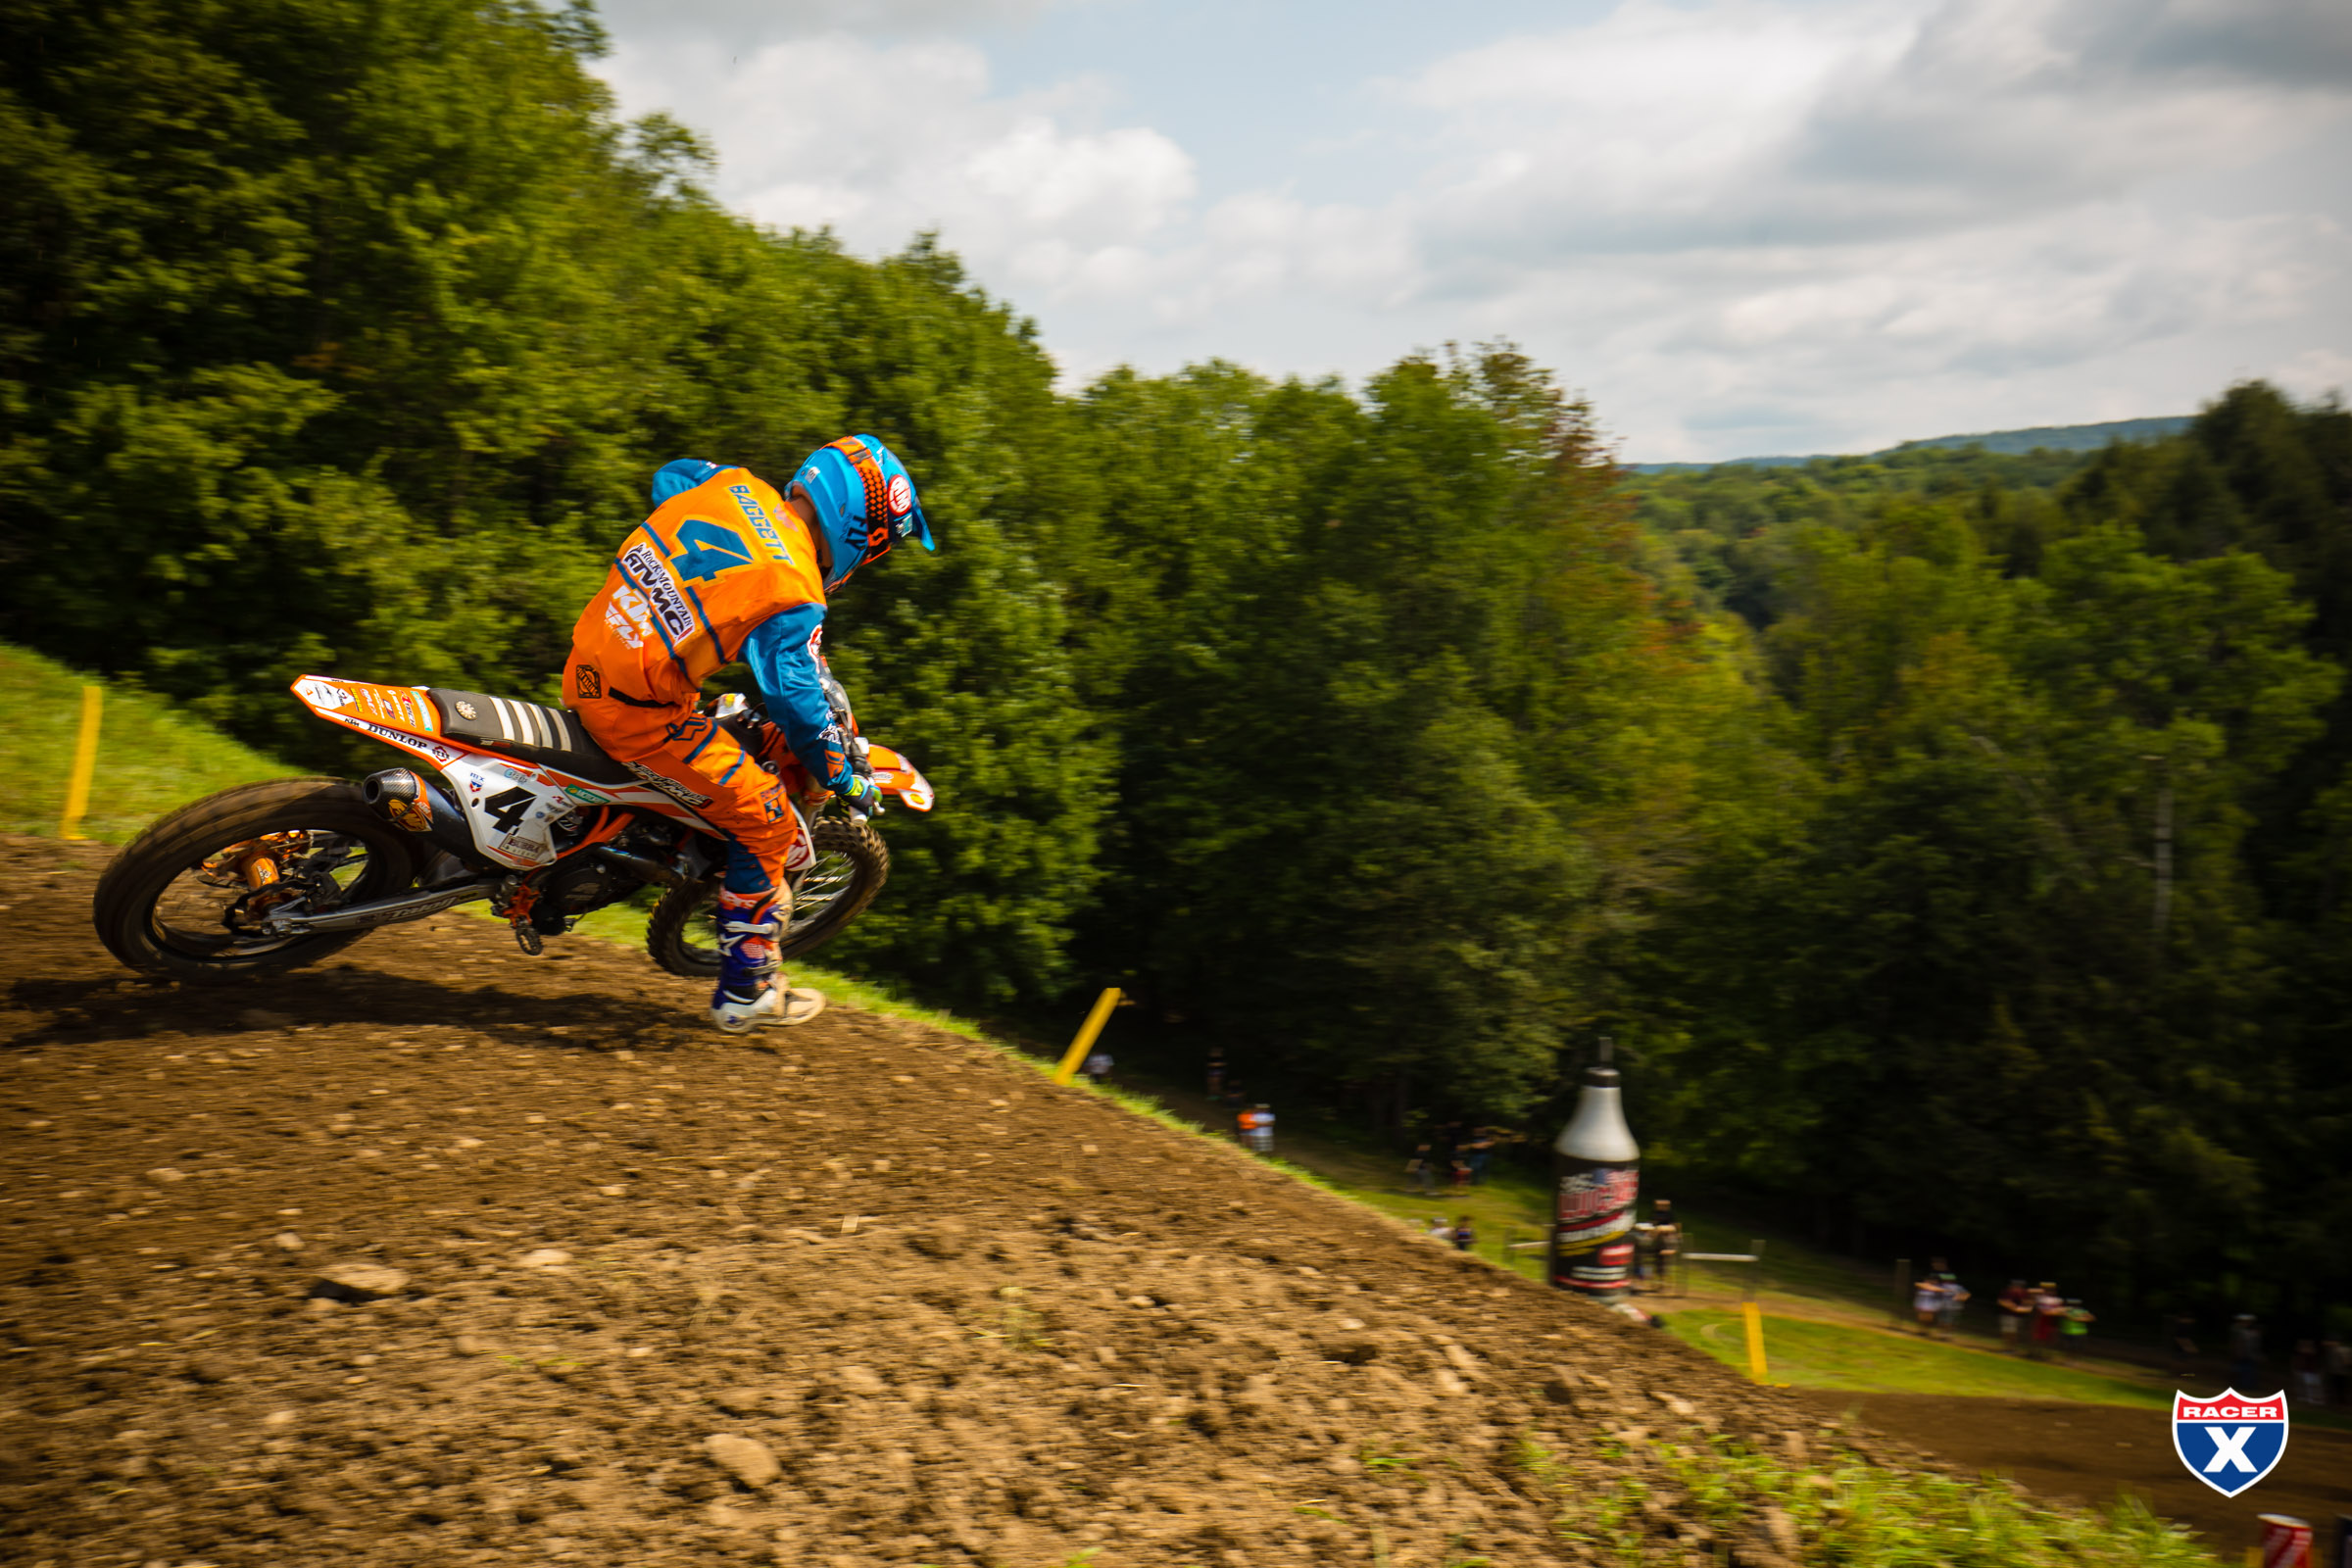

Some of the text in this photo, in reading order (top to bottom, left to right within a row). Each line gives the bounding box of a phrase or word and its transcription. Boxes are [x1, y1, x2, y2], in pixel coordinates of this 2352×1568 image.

[669, 518, 755, 582] 4
[728, 485, 796, 566] BAGGETT
[605, 601, 645, 649] FLY
[612, 585, 654, 637] KTM
[658, 571, 694, 627] MOUNTAIN
[368, 723, 427, 750] DUNLOP
[484, 786, 538, 834] 4
